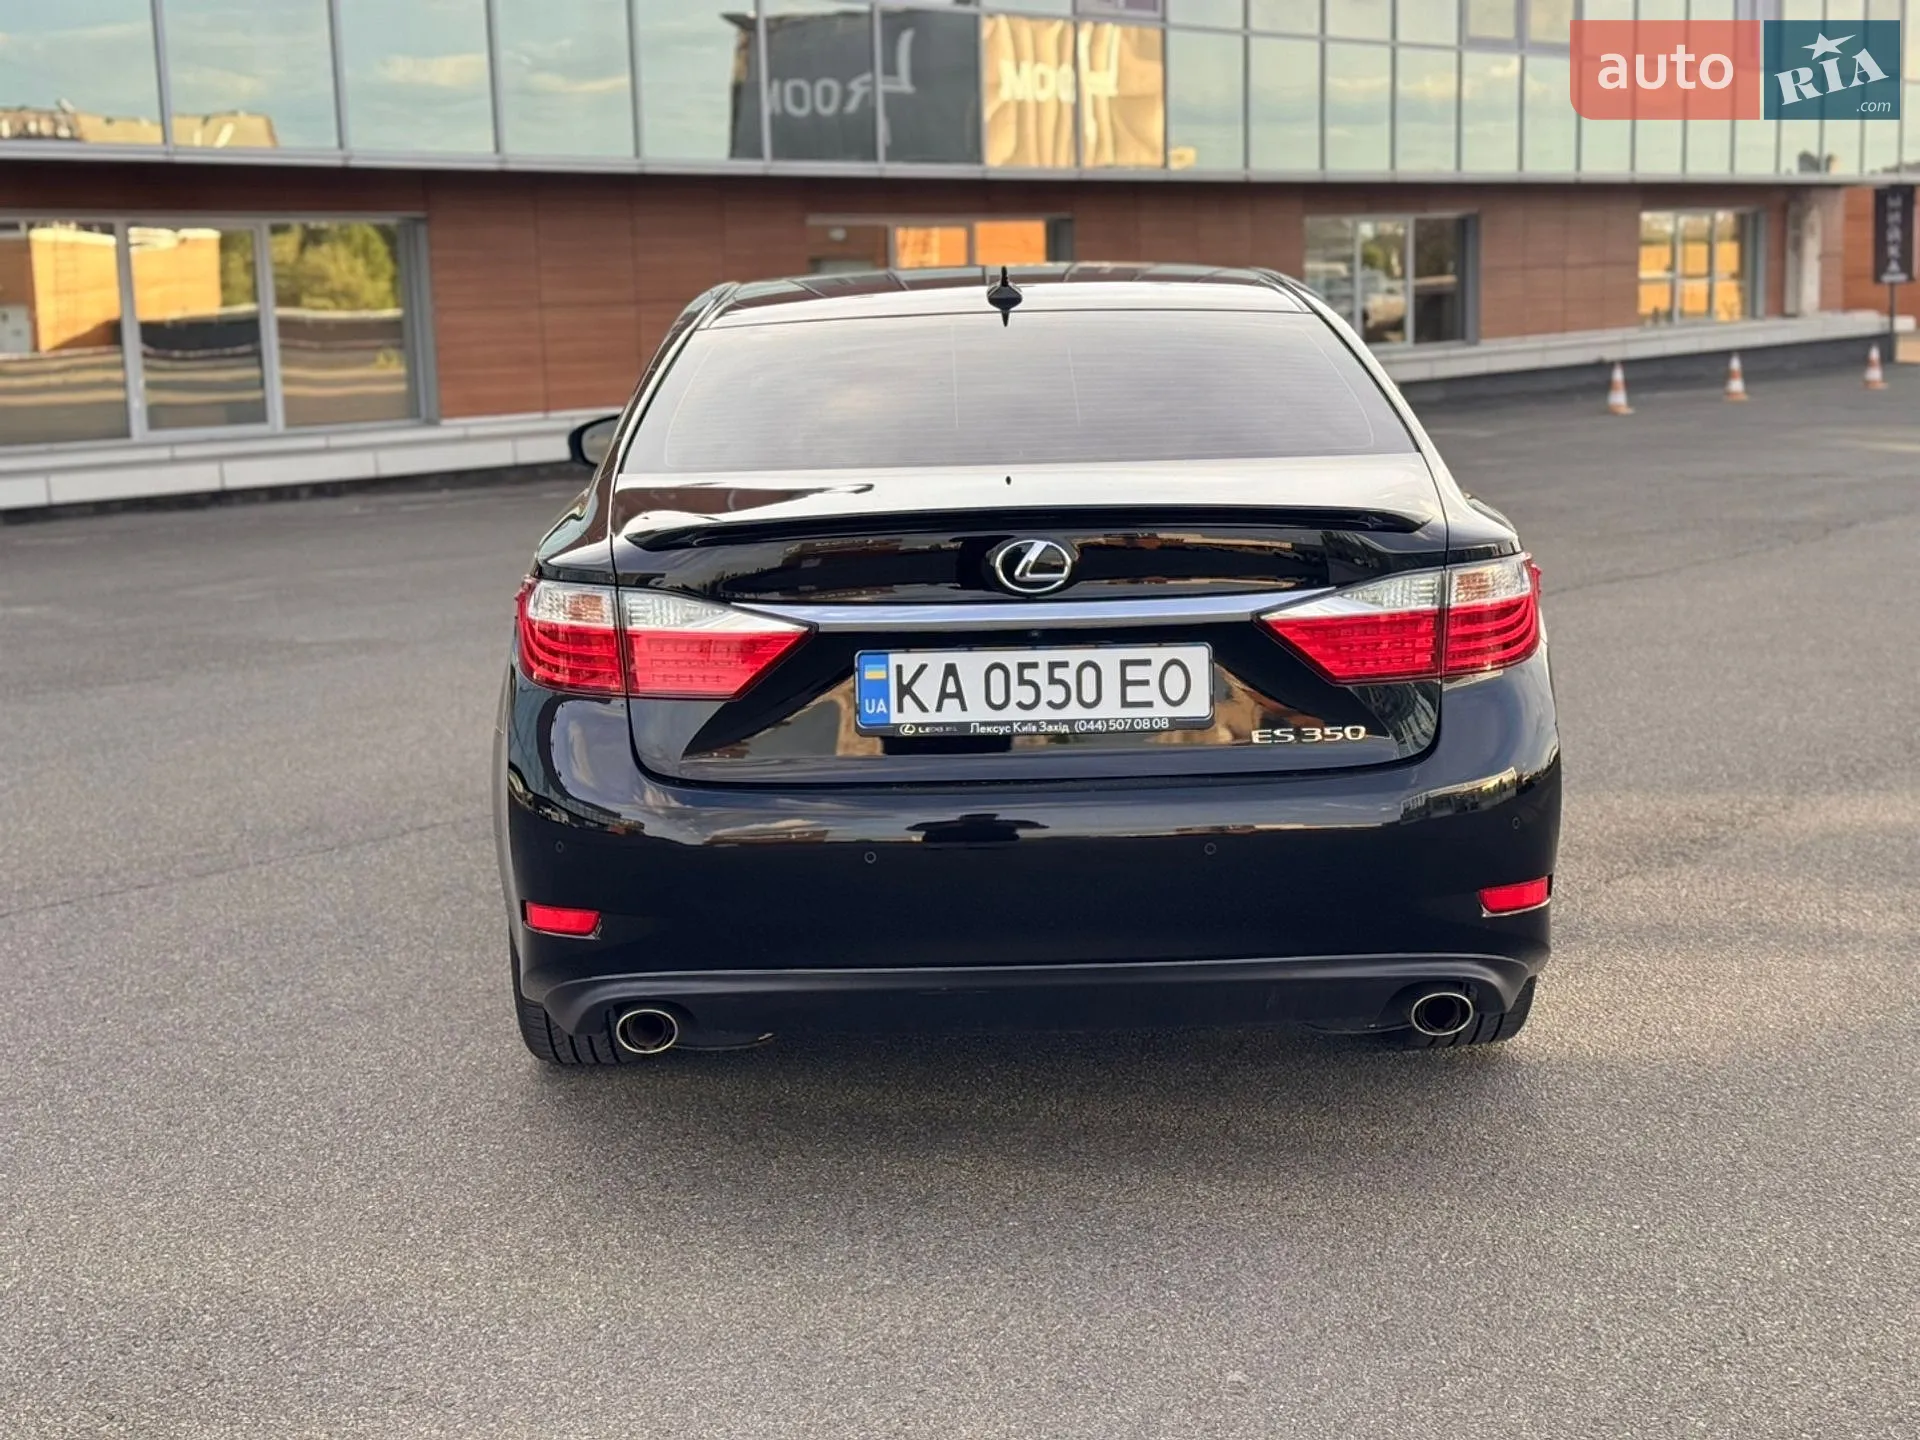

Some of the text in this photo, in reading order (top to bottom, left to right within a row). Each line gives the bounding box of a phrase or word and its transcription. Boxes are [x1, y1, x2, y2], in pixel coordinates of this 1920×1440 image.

[895, 657, 1192, 714] KA 0550 EO
[864, 698, 887, 714] UA
[970, 722, 1011, 735] Лексус
[1074, 719, 1107, 733] (044)
[1108, 718, 1132, 731] 507
[1251, 724, 1366, 744] ES 350
